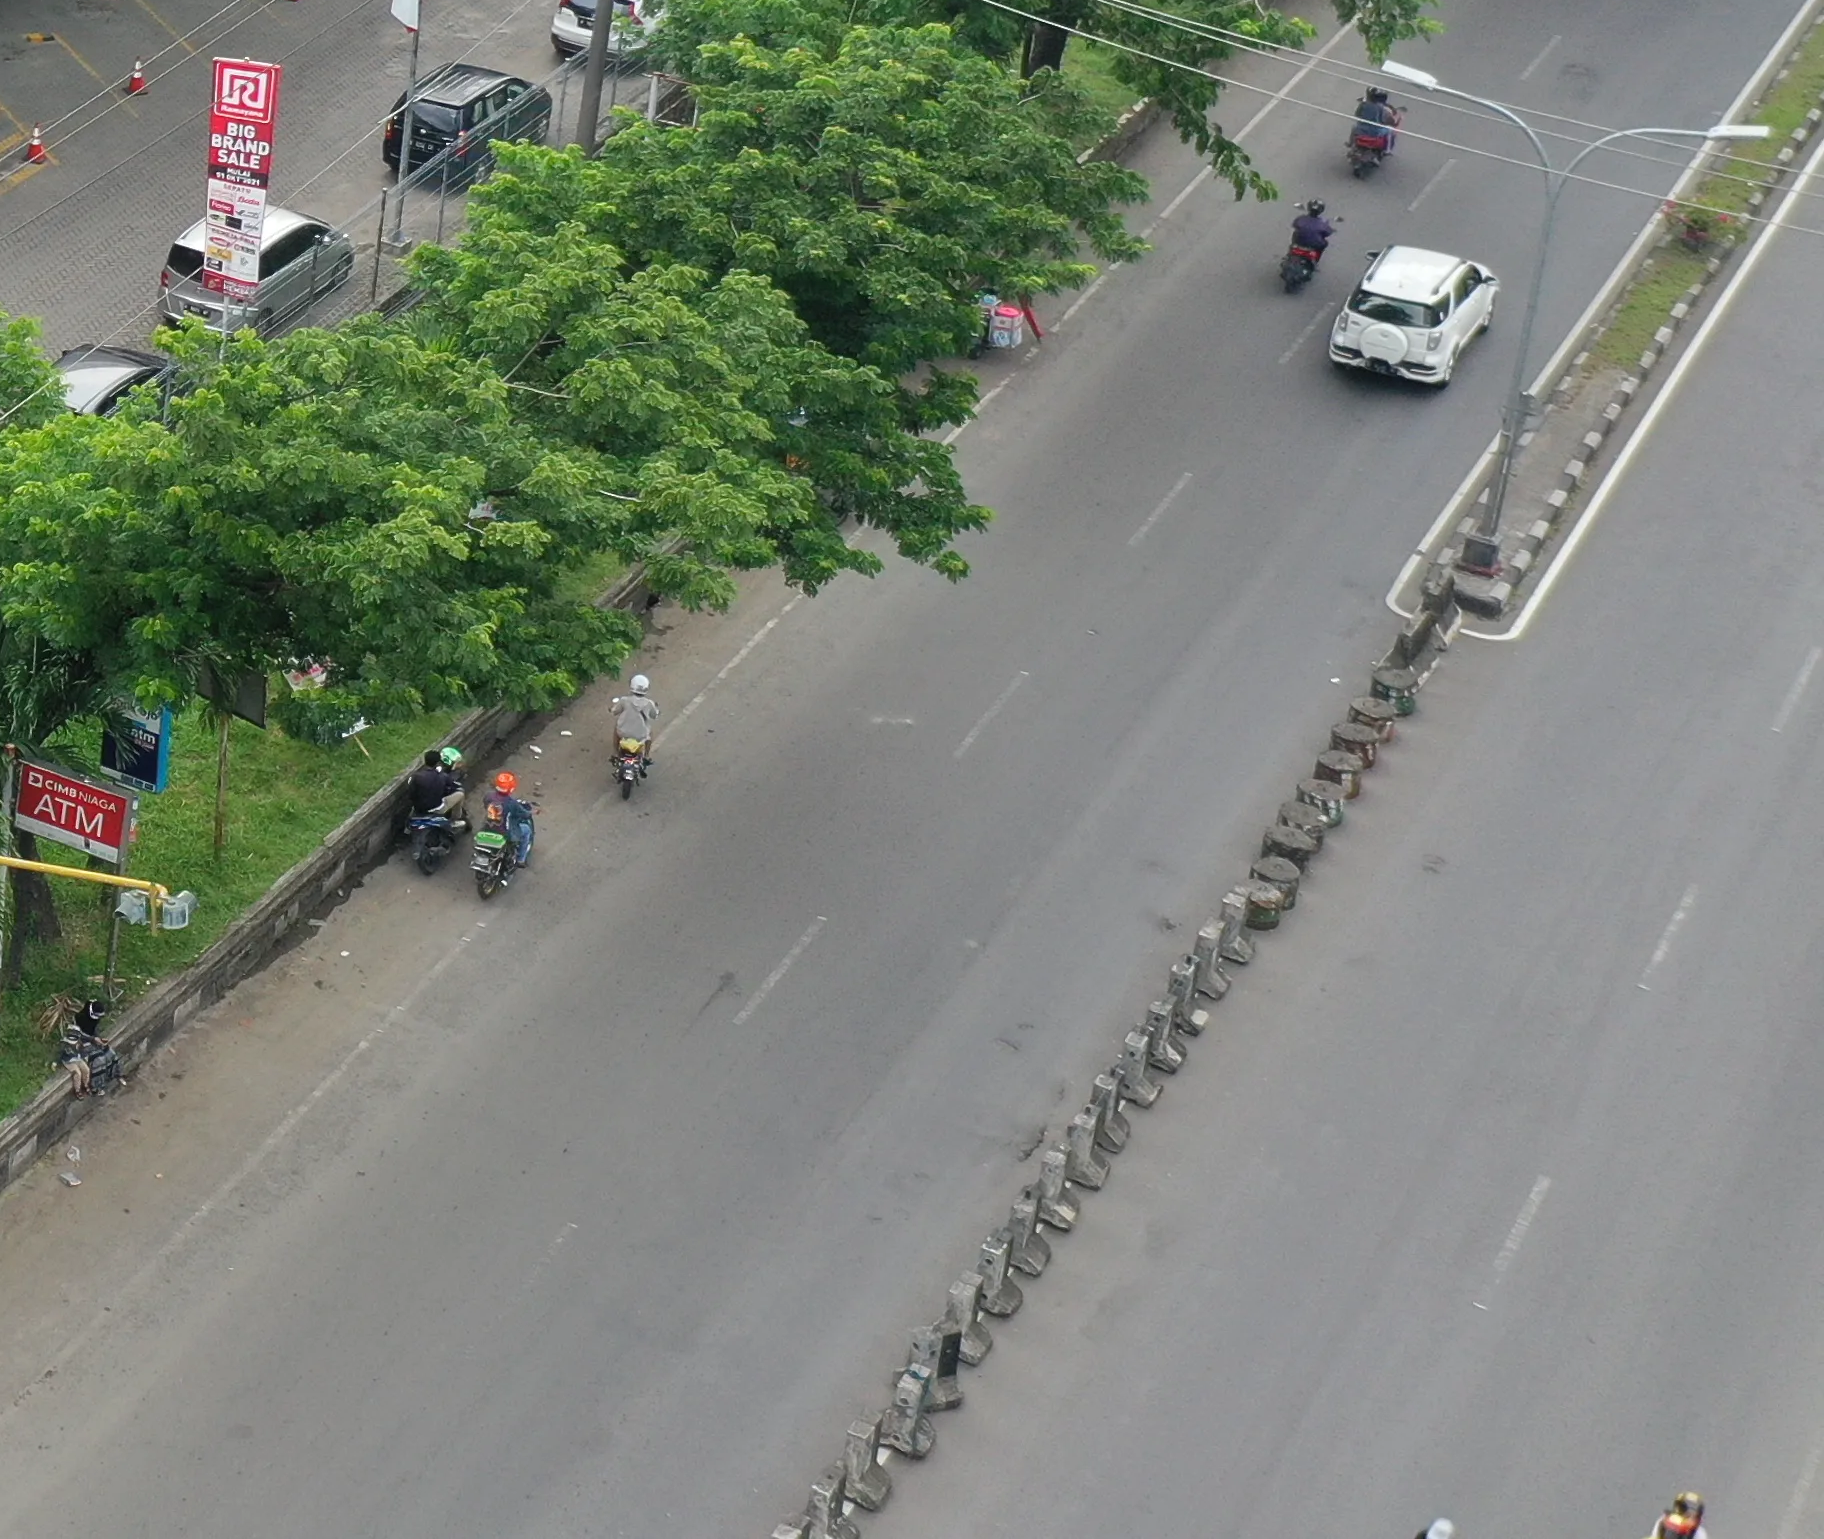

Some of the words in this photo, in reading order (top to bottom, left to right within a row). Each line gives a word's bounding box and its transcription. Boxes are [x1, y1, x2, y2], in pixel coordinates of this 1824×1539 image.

[227, 121, 256, 139] BIG
[211, 133, 270, 156] BRAND
[217, 148, 261, 170] SALE
[44, 779, 77, 798] CIMB
[79, 792, 116, 813] NIAGA
[33, 793, 104, 838] ATM
